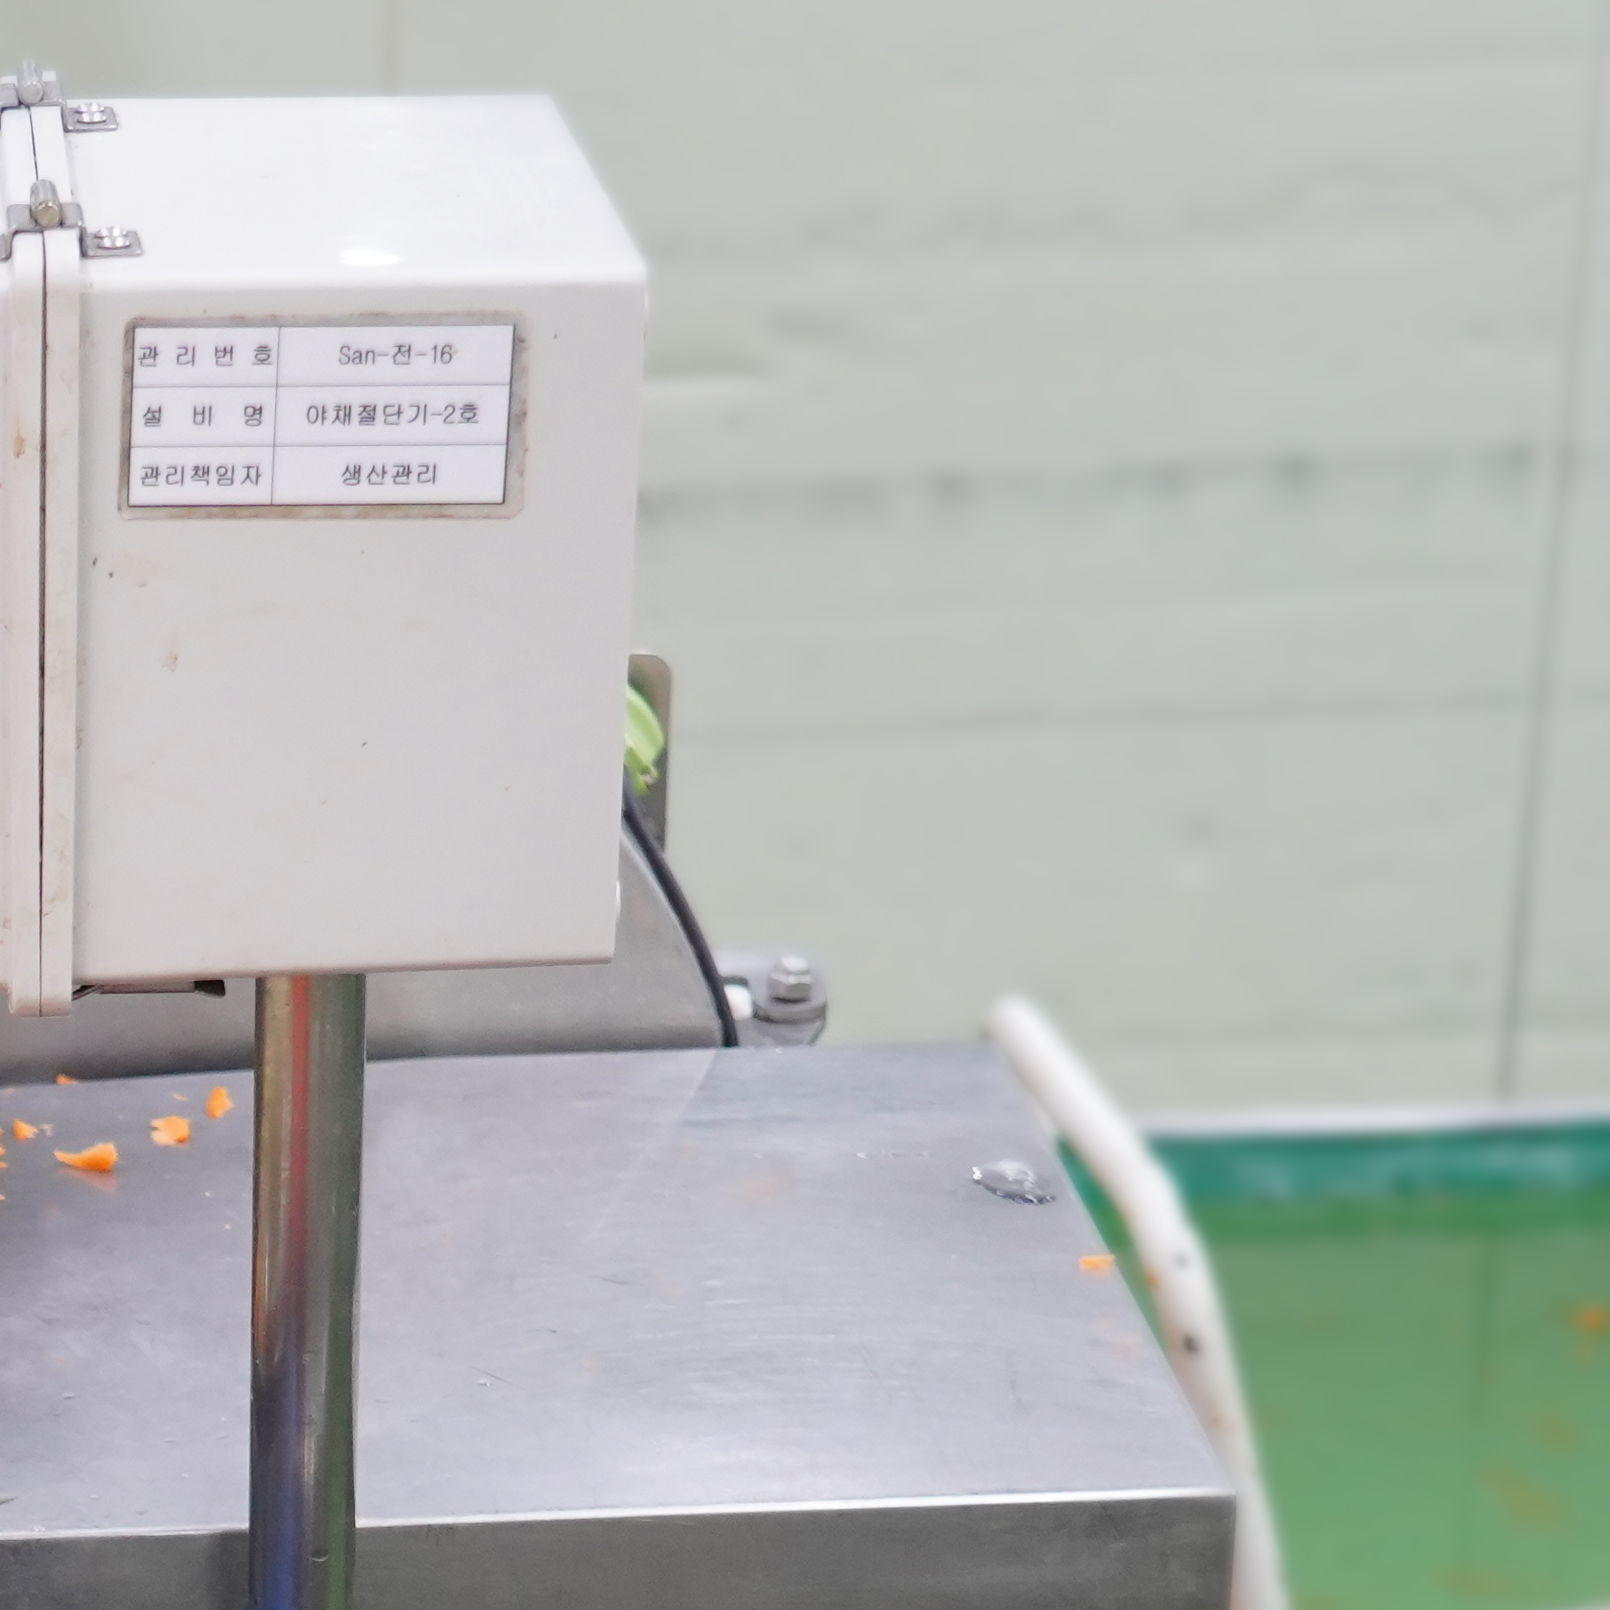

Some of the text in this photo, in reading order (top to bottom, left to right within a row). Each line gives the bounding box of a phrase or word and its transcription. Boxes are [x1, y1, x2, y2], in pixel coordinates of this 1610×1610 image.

[338, 344, 453, 366] San-전-16
[306, 403, 479, 425] 야채절단기-2호
[140, 465, 262, 487] 관리책임자
[341, 464, 437, 486] 생산관리
